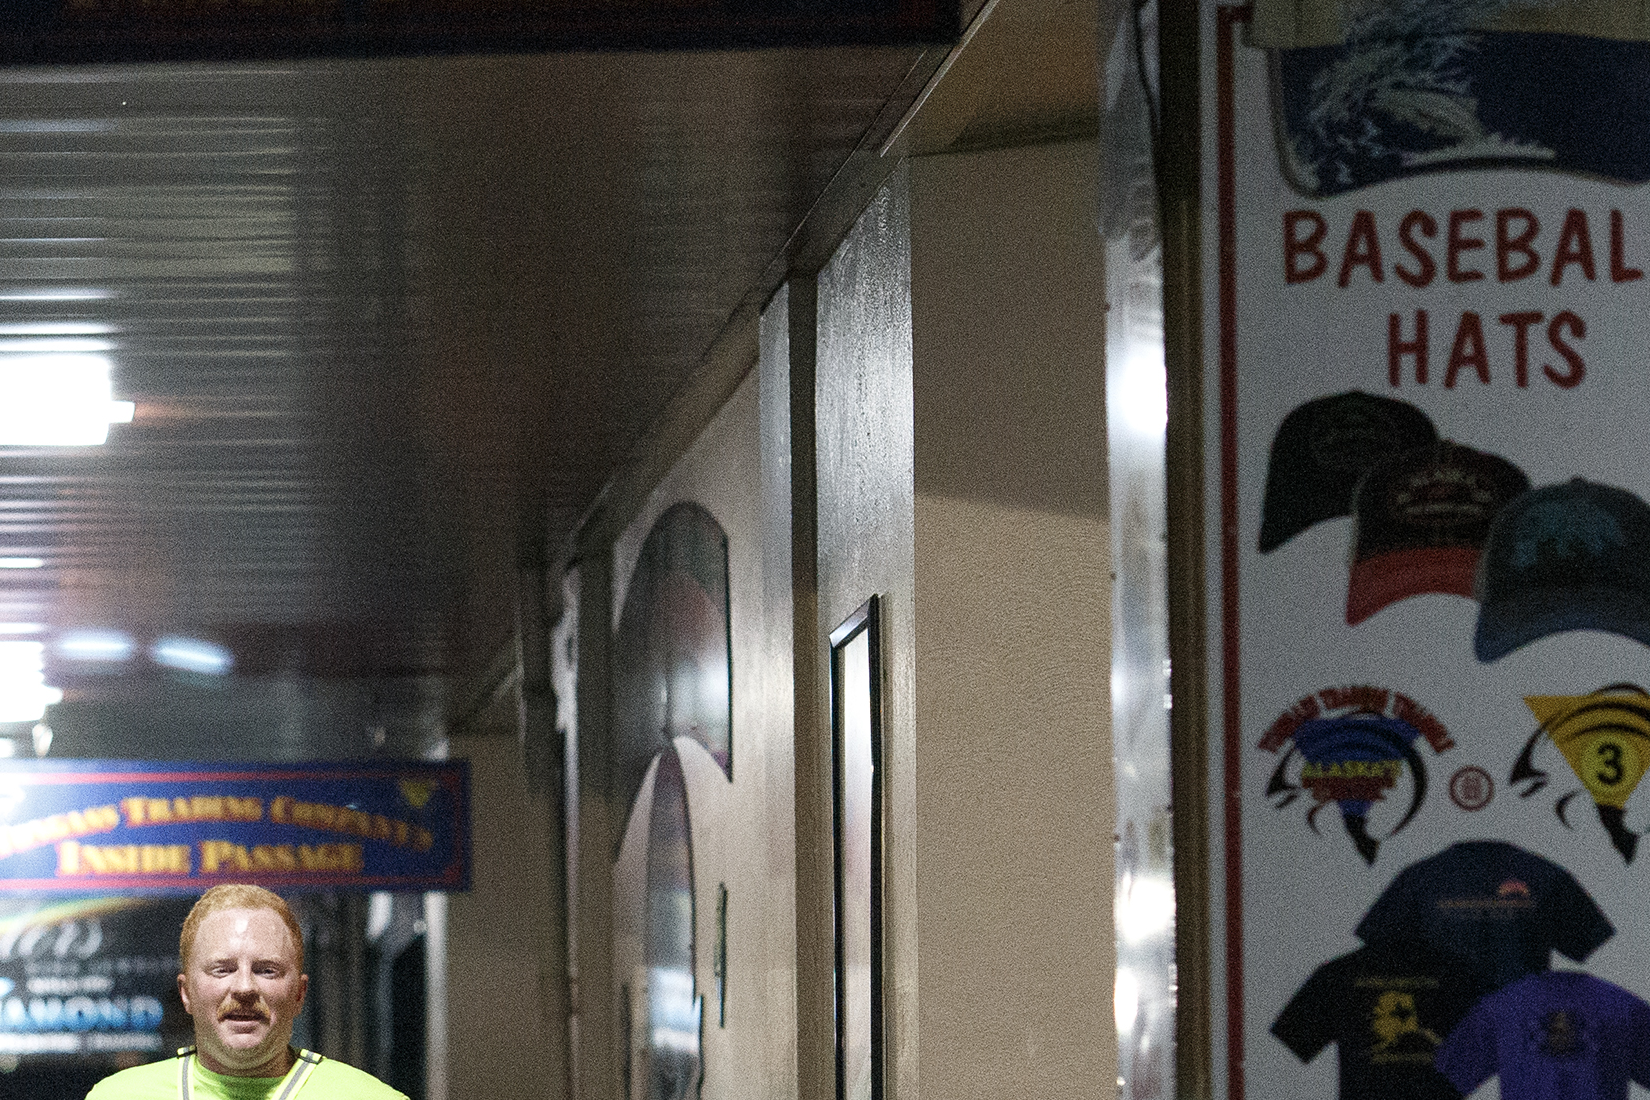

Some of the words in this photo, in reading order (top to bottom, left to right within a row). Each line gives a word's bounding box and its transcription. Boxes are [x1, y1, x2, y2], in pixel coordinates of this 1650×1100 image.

[1283, 207, 1644, 288] BASEBAL
[1388, 309, 1587, 390] HATS
[1596, 741, 1624, 785] 3
[56, 840, 192, 876] INSIDE
[198, 840, 365, 875] PASSAGE
